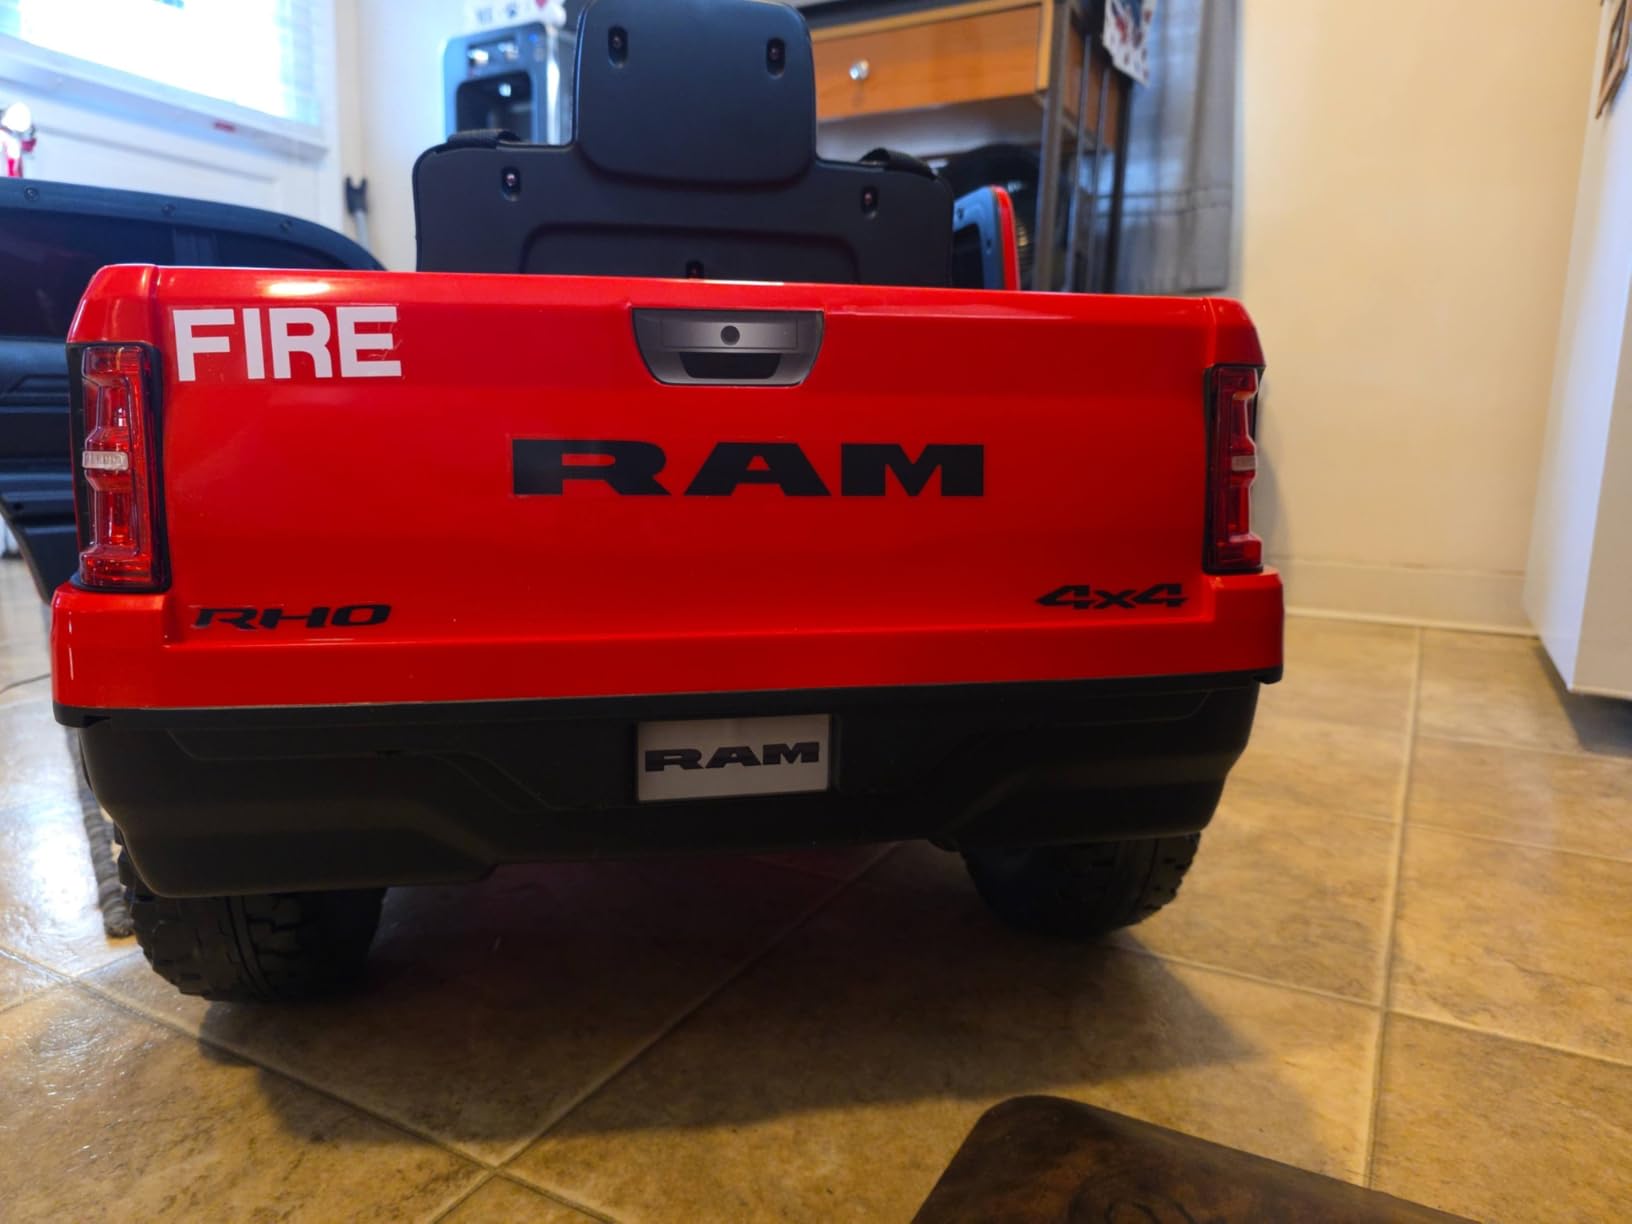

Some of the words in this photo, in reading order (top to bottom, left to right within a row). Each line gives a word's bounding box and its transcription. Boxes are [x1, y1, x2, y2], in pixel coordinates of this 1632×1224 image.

[173, 306, 402, 382] FIRE
[512, 439, 984, 497] RAM
[1036, 583, 1187, 610] 4x4
[195, 604, 391, 630] RHO
[645, 742, 819, 772] RAM
